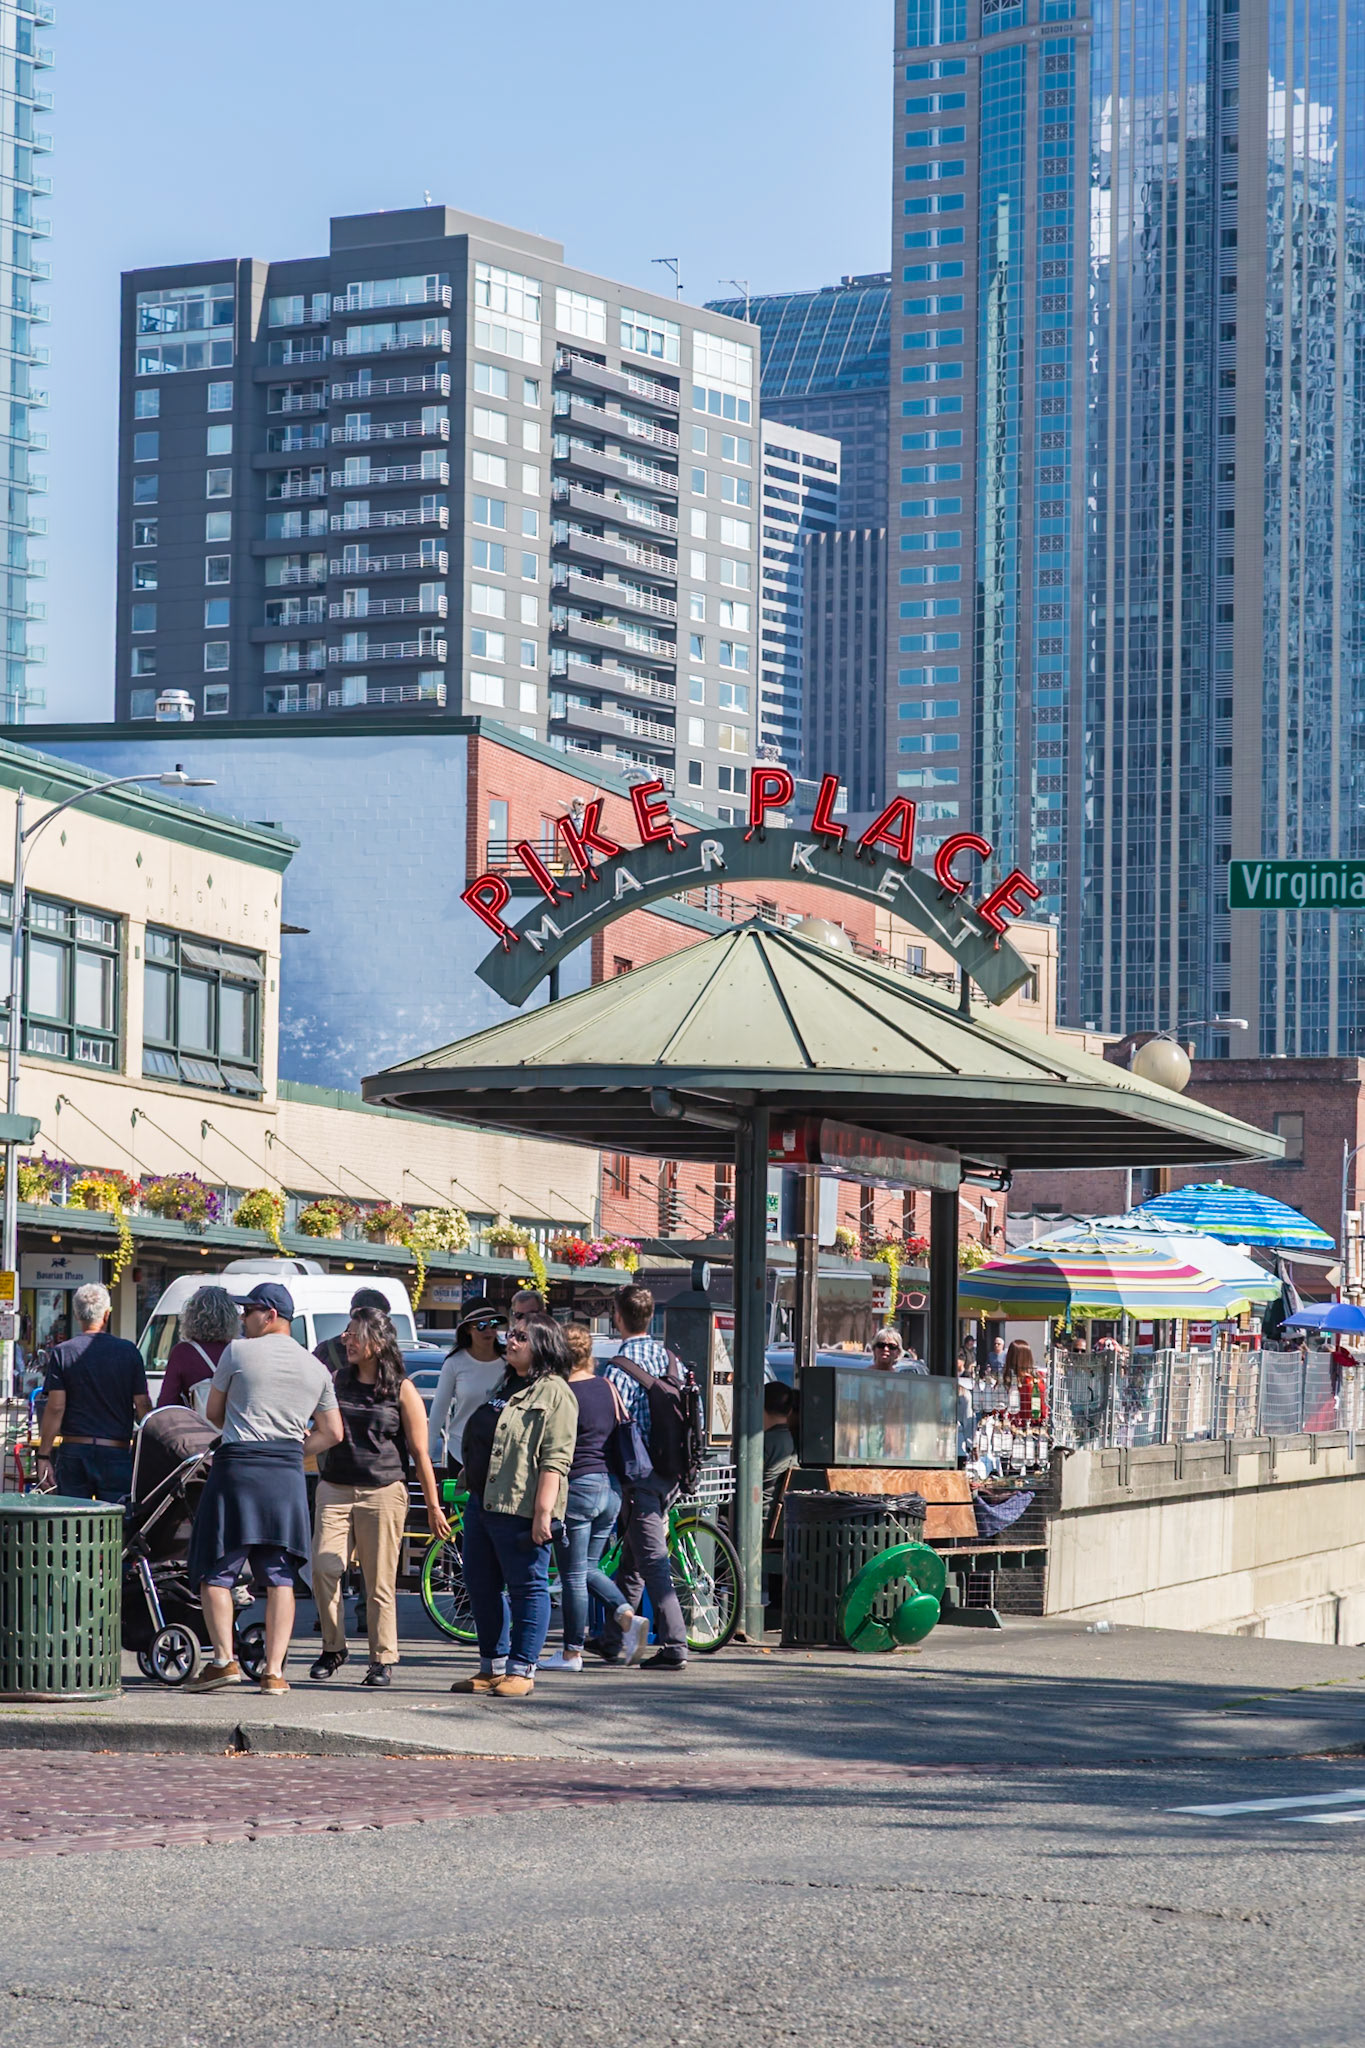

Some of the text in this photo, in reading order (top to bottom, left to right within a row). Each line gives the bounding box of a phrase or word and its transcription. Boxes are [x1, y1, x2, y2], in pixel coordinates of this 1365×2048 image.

[460, 766, 1043, 937] PIKE PLACE
[1242, 864, 1365, 907] Virginia
[146, 876, 270, 922] WAGNER
[524, 838, 982, 951] MARKET
